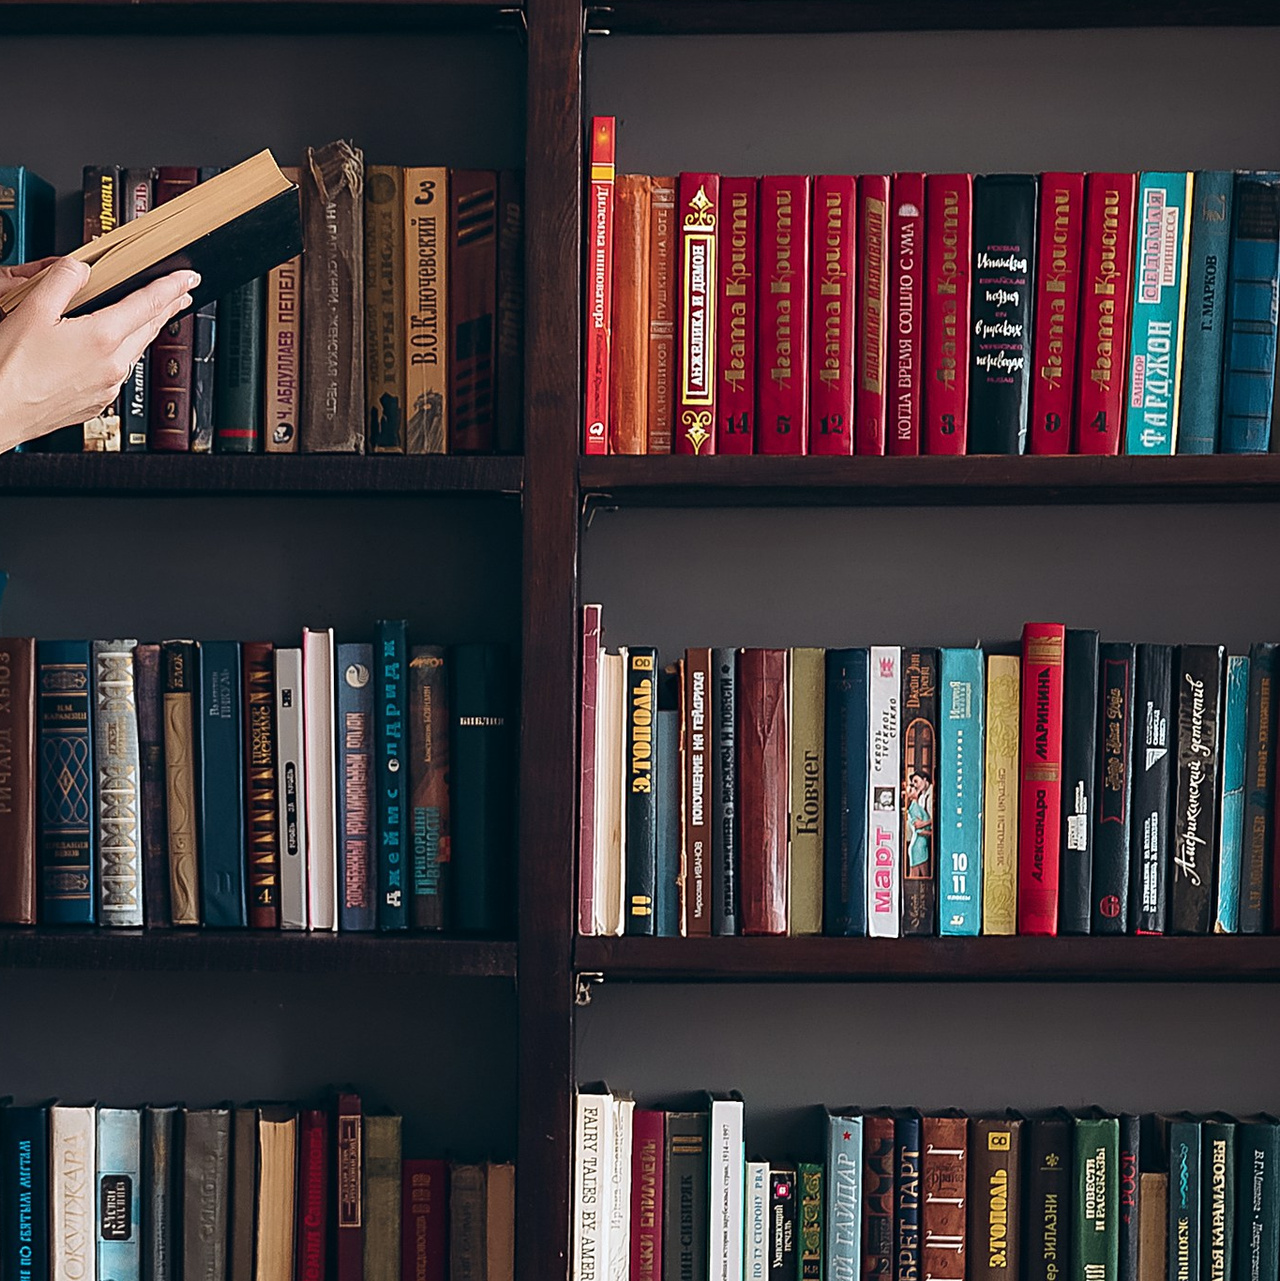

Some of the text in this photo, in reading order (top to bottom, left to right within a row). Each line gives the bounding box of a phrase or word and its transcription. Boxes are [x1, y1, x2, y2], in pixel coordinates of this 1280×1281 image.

[414, 181, 436, 206] 3
[1093, 189, 1121, 295] Кристи
[1143, 191, 1163, 301] СЕДЬМАЯ
[1162, 209, 1177, 283] ПРИНЦЕССА
[278, 269, 295, 324] ПЕПЕЛ
[592, 185, 610, 328] Дилемма инноватора
[865, 211, 883, 382] ВЛАДИМИР МАЯКОВСКИЙ
[1040, 188, 1072, 433] Агата Кристи 9
[690, 243, 707, 388] АНЖЕЛИКА И ДЕМОН
[723, 191, 752, 434] Агата Кристи 14
[769, 189, 796, 435] Агата Кристи 5
[818, 191, 847, 434] Агата Кристи 12
[897, 222, 915, 441] КОГДА ВРЕМЯ СОШЛО С УМА
[935, 190, 964, 435] Агата Кристи 3
[1090, 299, 1114, 392] Агата
[279, 331, 295, 405] АБДУЛЛАЕВ
[1133, 355, 1145, 408] ЭЛИНОР
[1140, 319, 1173, 449] ФАРДЖОН
[691, 671, 705, 919] Мирослав ИВАНОВ ПОКУШЕНИЕ НА ГЕЙДРИХА
[795, 750, 821, 837] Ковчег
[1031, 667, 1051, 883] Александра МАРИНИНА
[1174, 673, 1211, 887] Американский детектив
[875, 827, 894, 913] март
[582, 1106, 599, 1153] FAIRY
[582, 1156, 599, 1204] TALES
[899, 1145, 921, 1210] ГАРТ
[62, 1128, 88, 1280] ОКУДЖАВА
[581, 1209, 597, 1232] BY
[752, 1167, 764, 1279] ПО ТУ СТОРОНУ РВА
[832, 1152, 856, 1247] ГАЙДАР
[1043, 1193, 1059, 1260] ЗИЛАЗНИ
